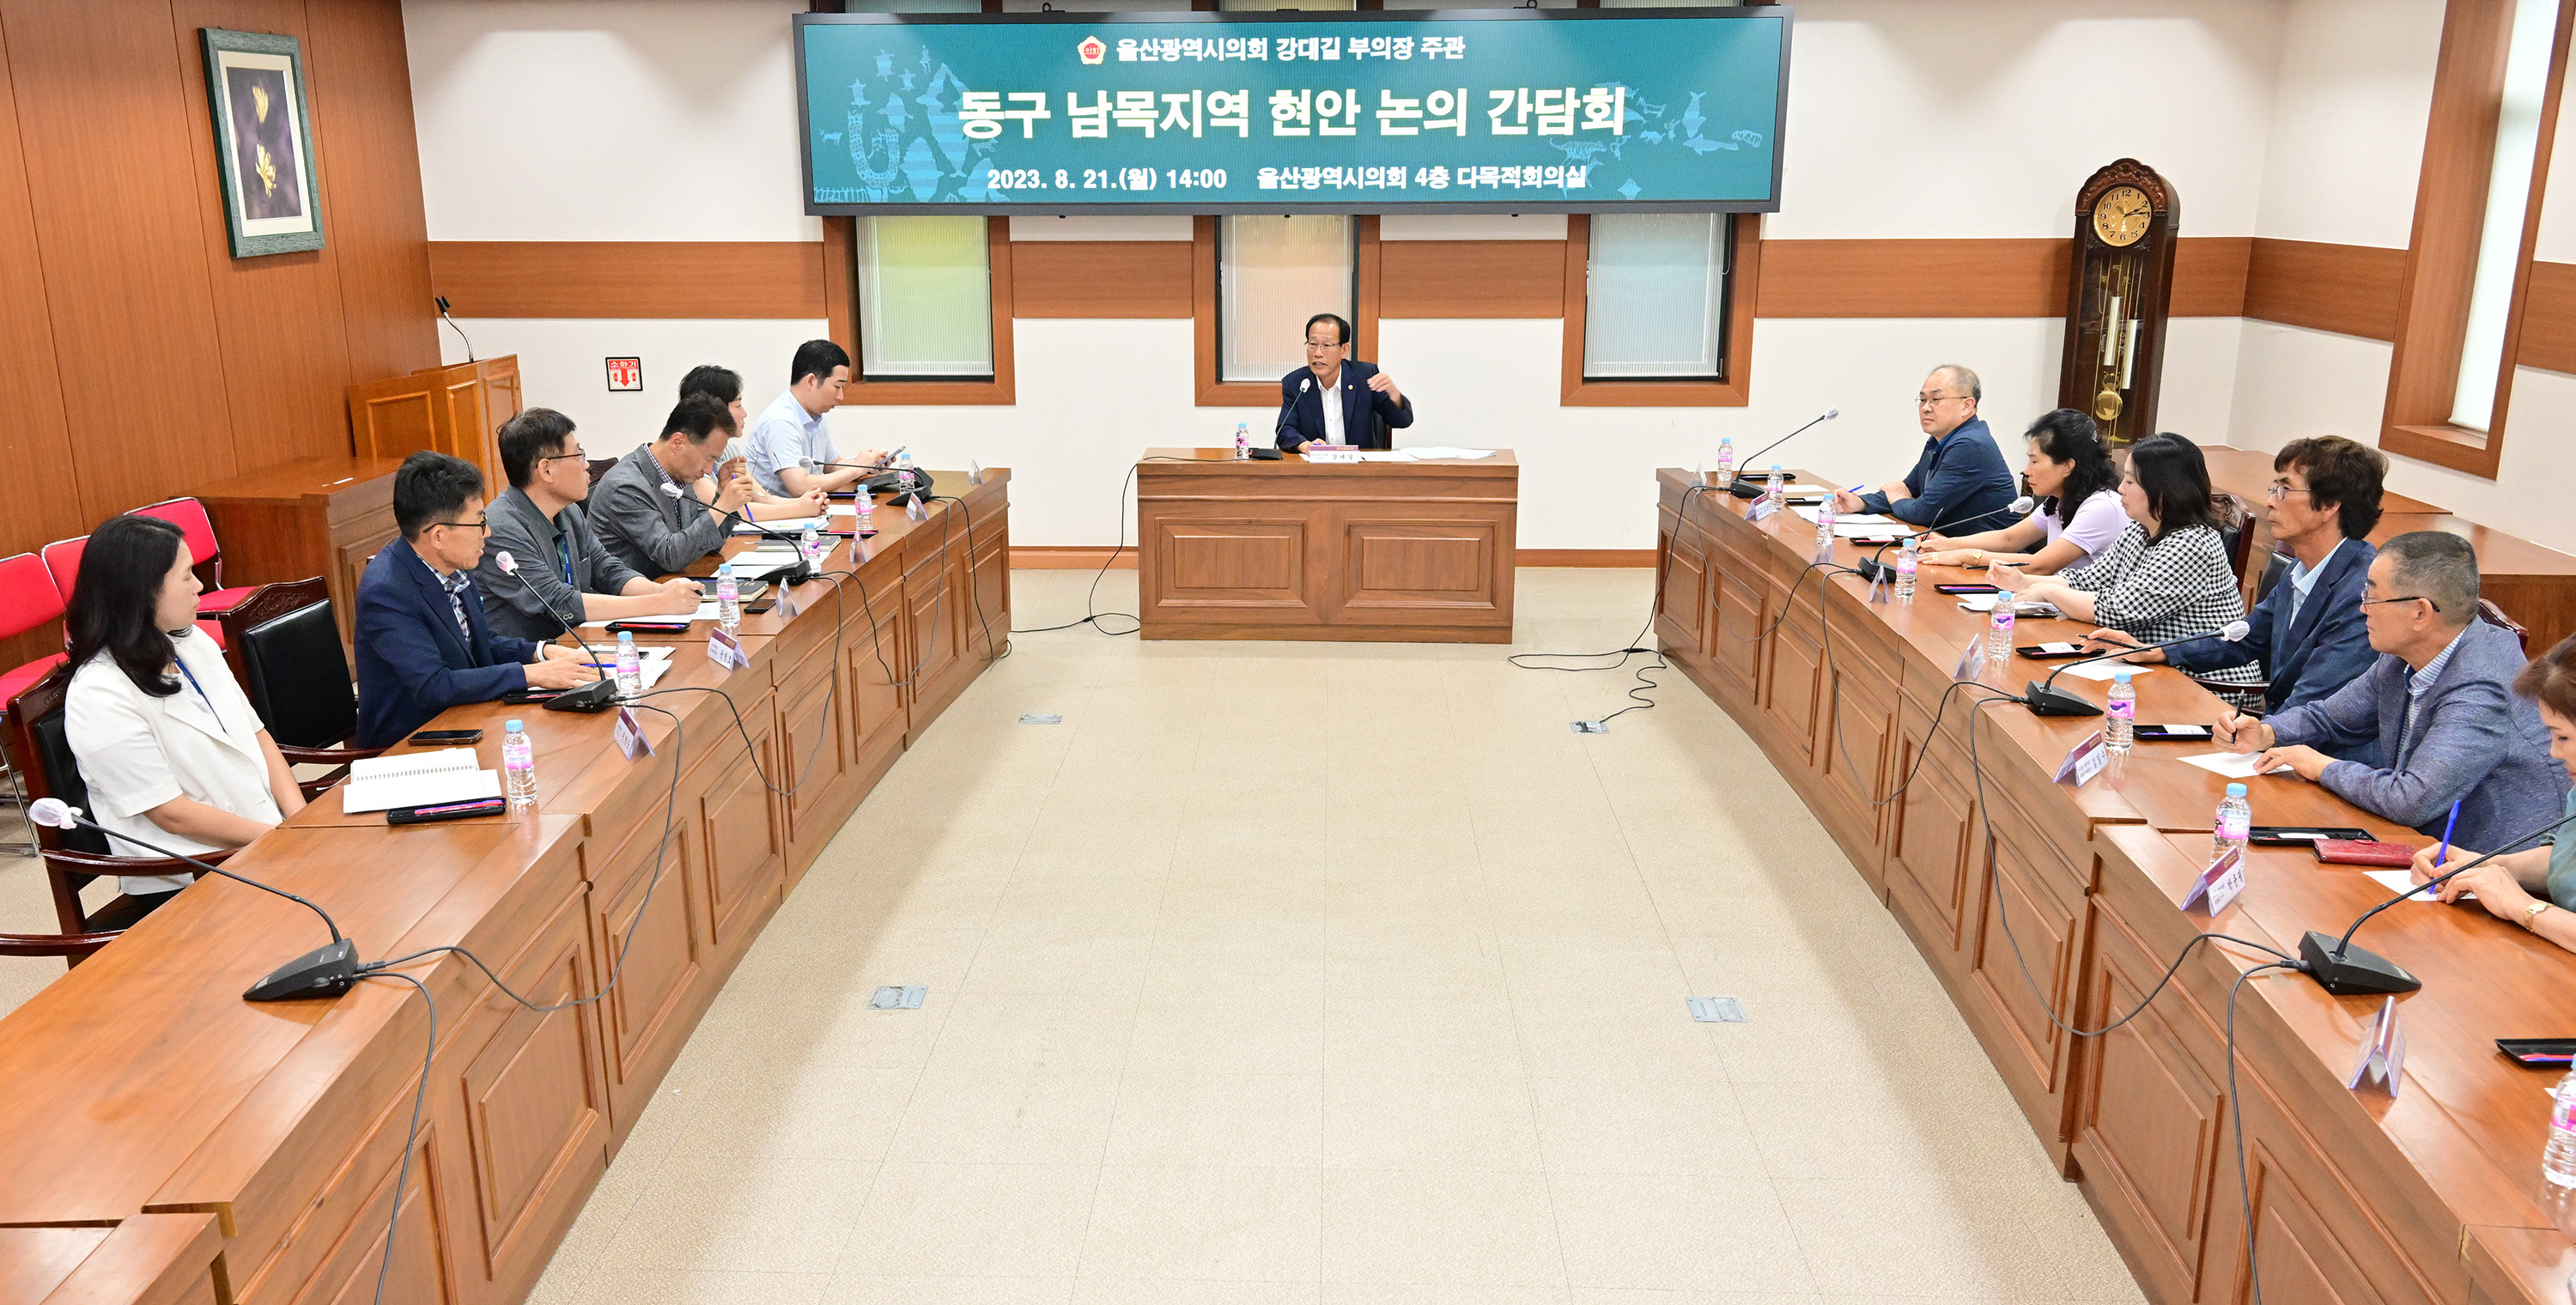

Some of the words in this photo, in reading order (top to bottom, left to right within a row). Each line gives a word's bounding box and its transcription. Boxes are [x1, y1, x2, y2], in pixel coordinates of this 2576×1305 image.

[1116, 37, 1267, 62] 울산광역시의회
[1276, 36, 1340, 61] 강대길
[1347, 36, 1415, 60] 부의장
[1420, 36, 1467, 60] 주관
[958, 91, 1052, 139] 동구
[1067, 89, 1249, 138] 남목지역
[1268, 88, 1361, 137] 현안
[1376, 88, 1467, 137] 논의
[1487, 87, 1625, 136] 간담회
[987, 169, 1048, 189] 2023.
[1054, 169, 1076, 189] 8.
[1083, 168, 1157, 191] 21.(월)
[1166, 169, 1227, 189] 14:00
[1256, 166, 1406, 190] 울산광역시의회
[1414, 167, 1450, 190] 4층
[1457, 165, 1587, 189] 다목적회의실
